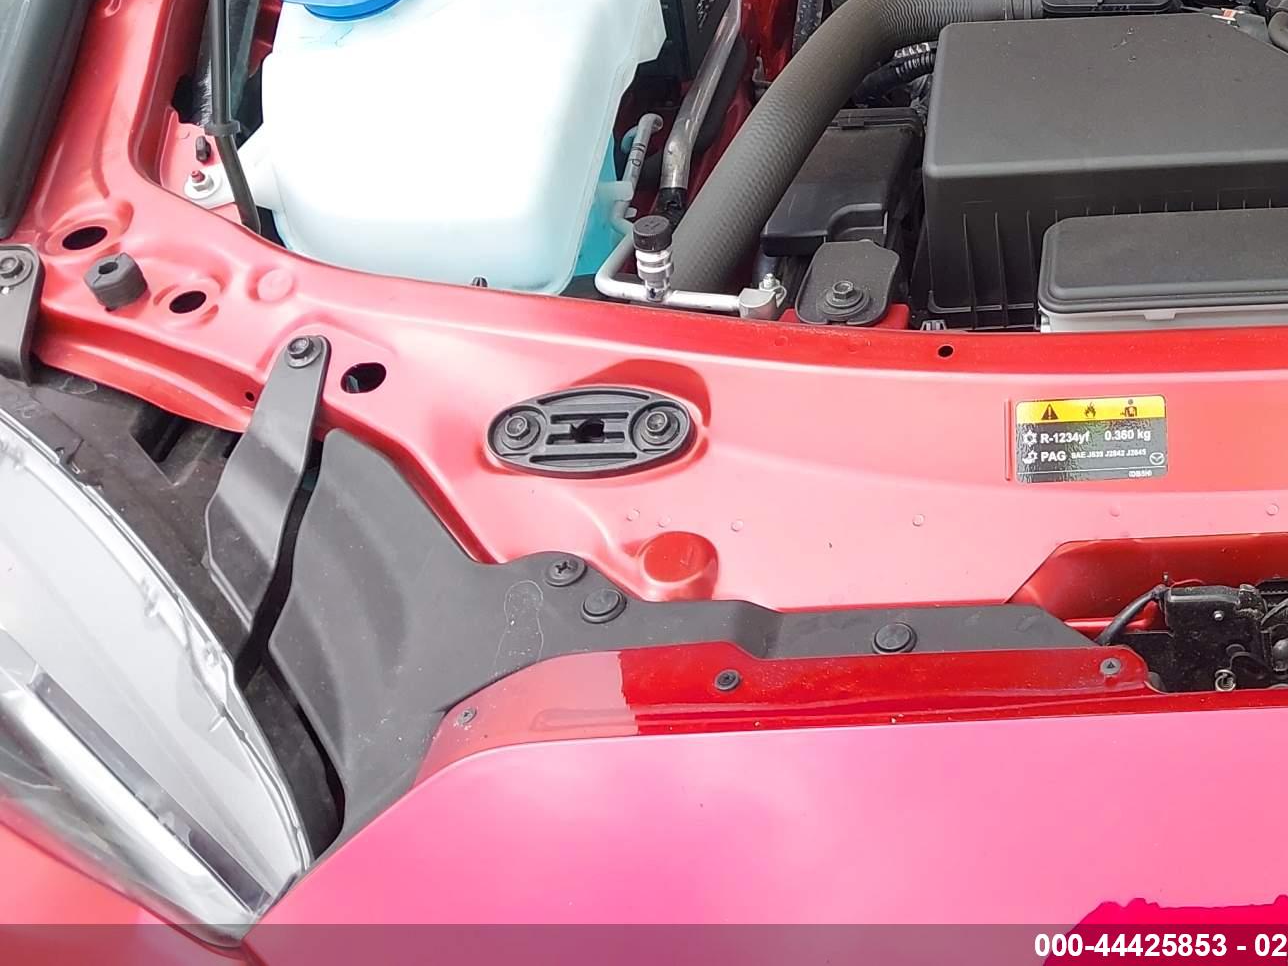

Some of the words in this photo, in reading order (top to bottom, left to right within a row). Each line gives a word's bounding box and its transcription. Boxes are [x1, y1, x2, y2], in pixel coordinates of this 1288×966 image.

[1040, 431, 1090, 444] R-1234yf
[1137, 428, 1151, 442] kg
[1040, 450, 1067, 462] PAG
